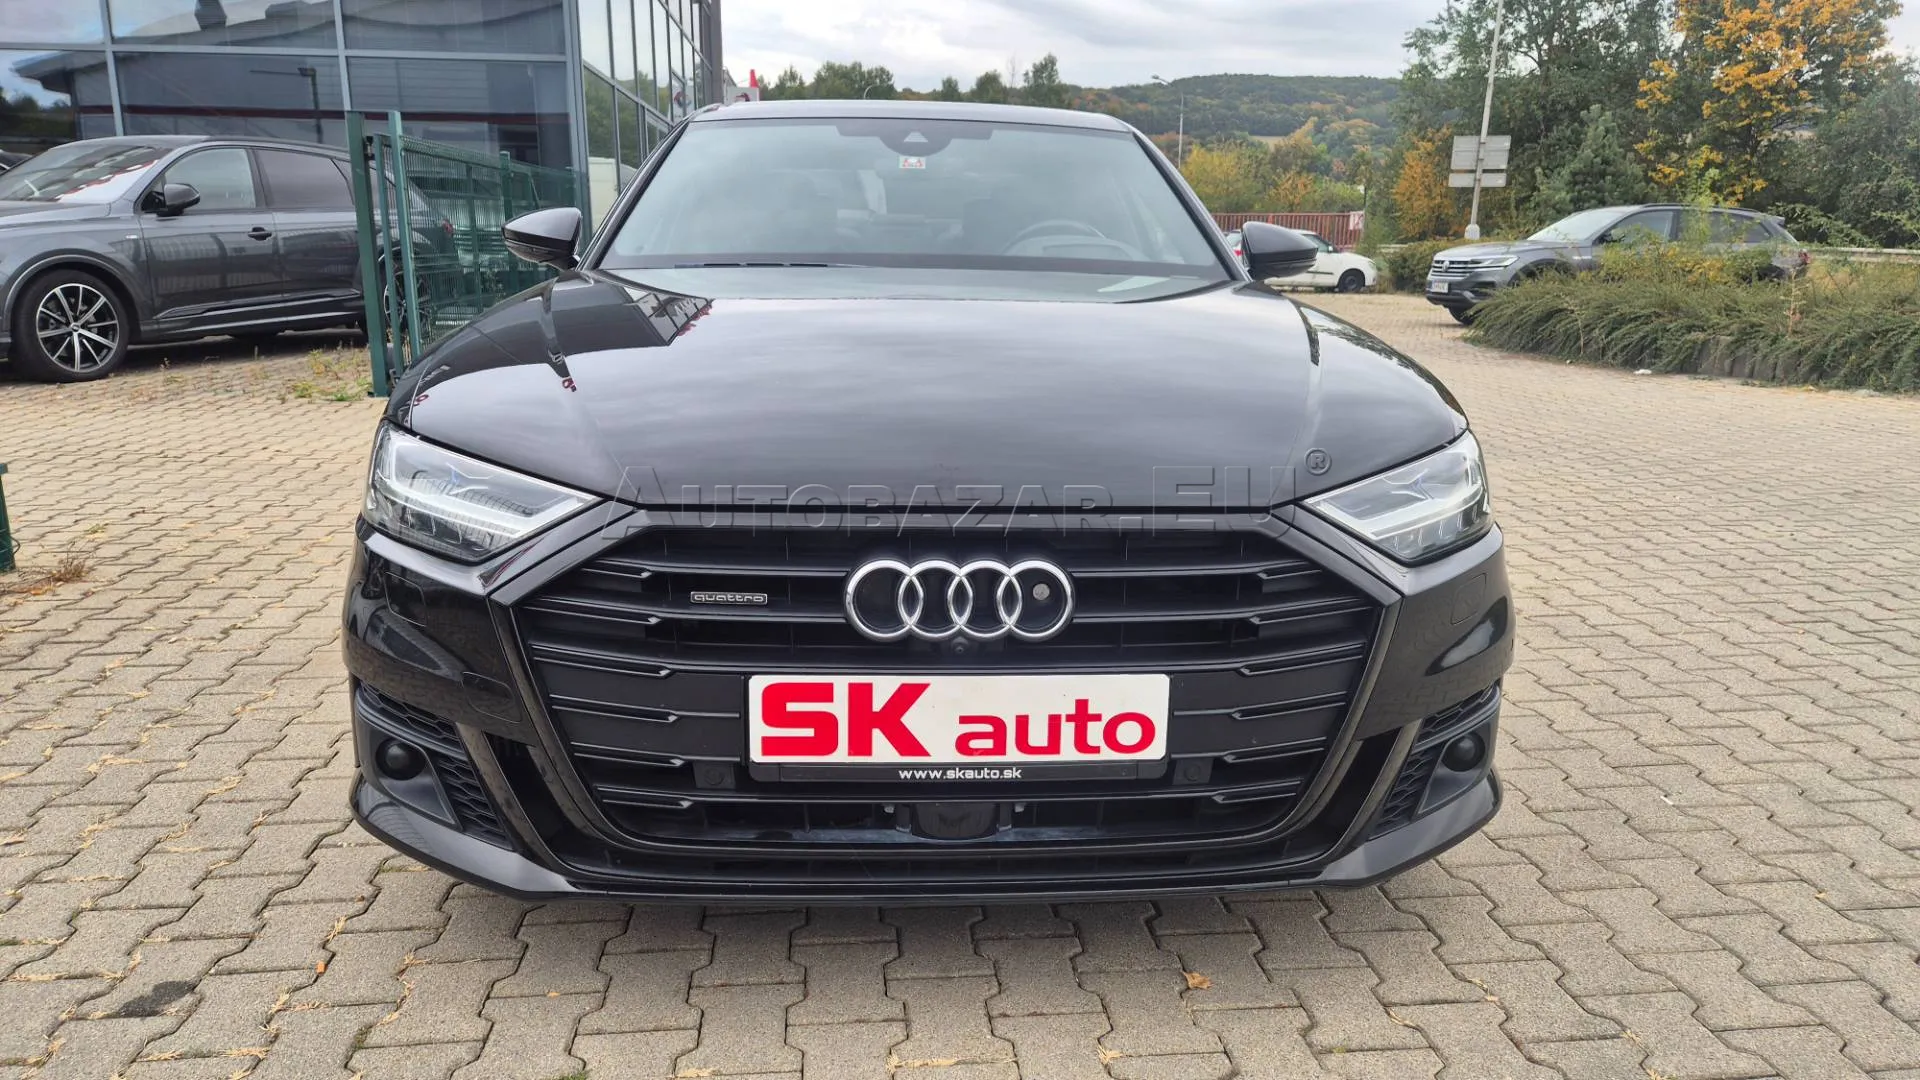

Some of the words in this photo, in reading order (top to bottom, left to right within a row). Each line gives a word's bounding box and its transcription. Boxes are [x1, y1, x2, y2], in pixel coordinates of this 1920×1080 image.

[693, 593, 765, 603] quattro
[760, 682, 932, 757] SK
[955, 698, 1156, 757] auto
[898, 767, 1021, 779] www.skauto.sk
